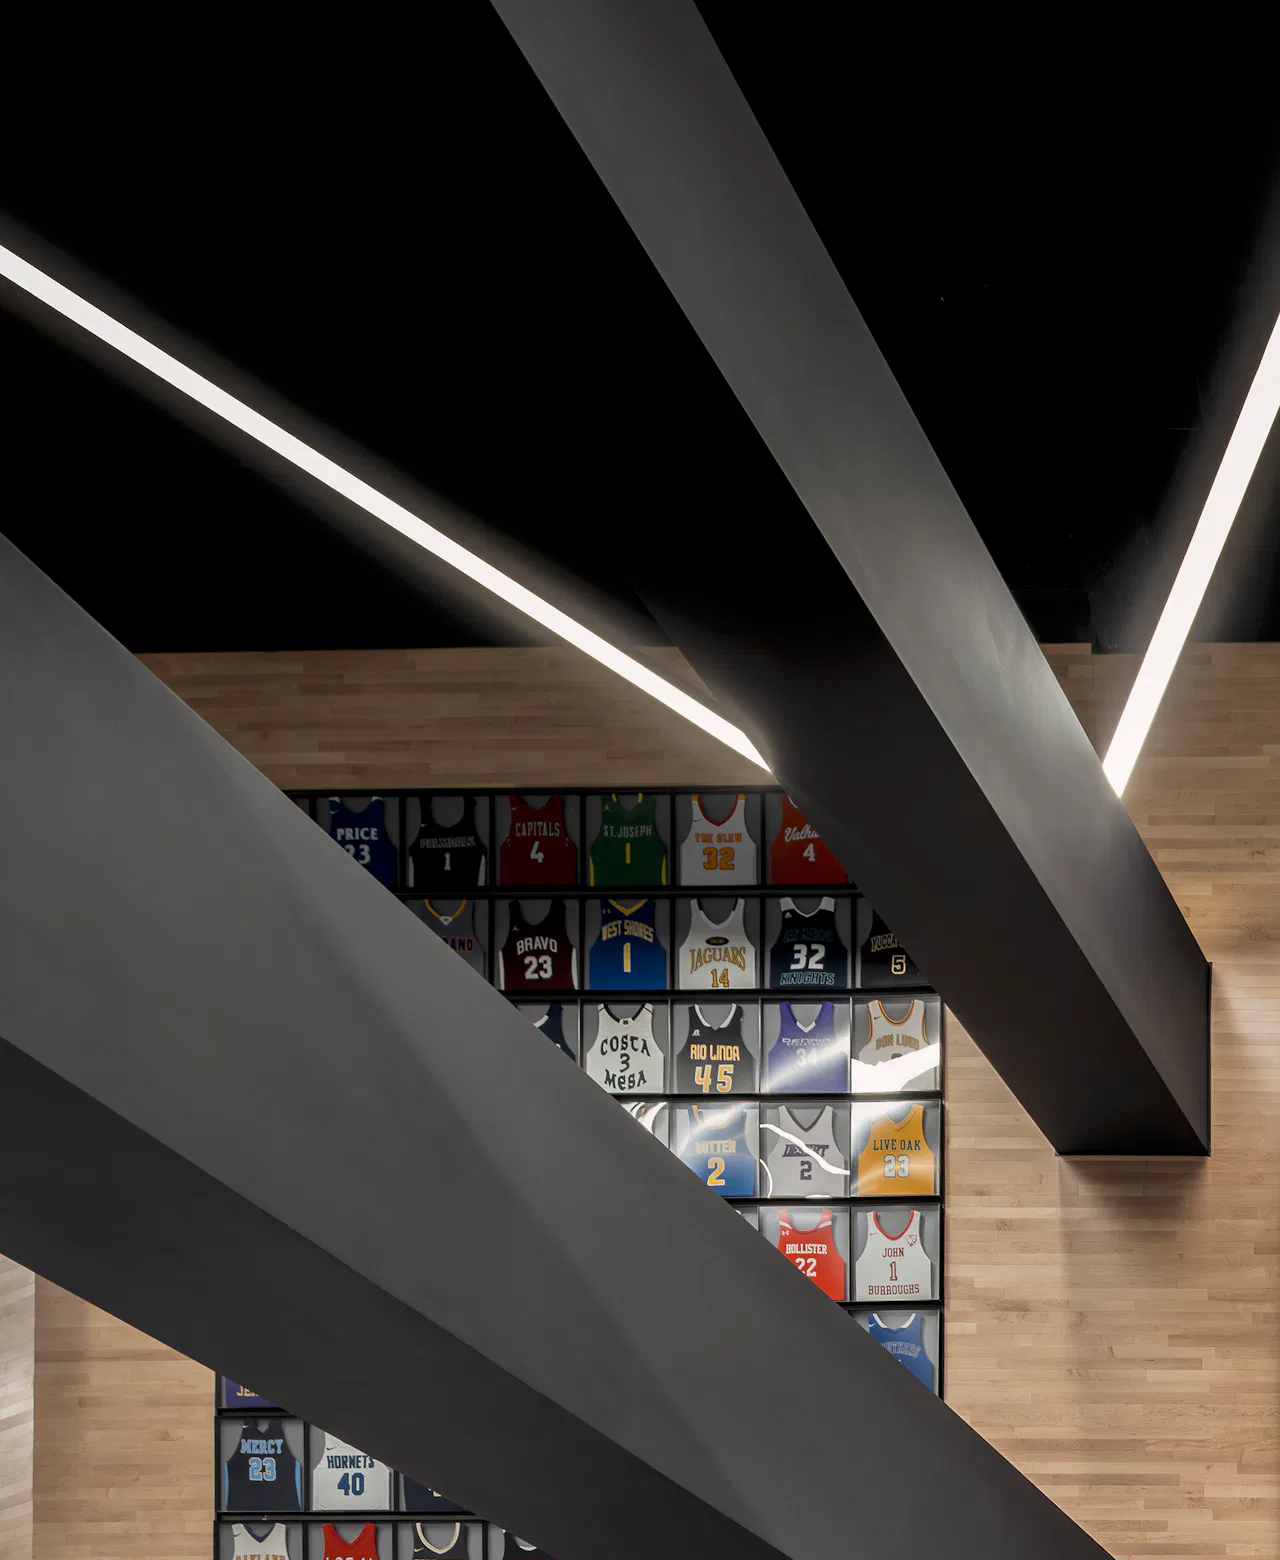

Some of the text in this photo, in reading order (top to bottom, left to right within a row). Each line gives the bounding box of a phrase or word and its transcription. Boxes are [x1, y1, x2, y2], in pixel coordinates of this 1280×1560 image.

[336, 828, 378, 841] PRICE
[515, 821, 560, 838] CAPITALS
[702, 846, 735, 870] 32
[516, 936, 557, 956] BRAVO
[790, 943, 825, 969] 32
[524, 955, 553, 980] 23
[690, 946, 746, 973] JAGUARS
[695, 1065, 733, 1092] 45
[873, 1139, 921, 1151] LIVE OAK
[786, 1244, 827, 1255] HOLLISTER
[882, 1247, 904, 1258] JOHN
[868, 1284, 920, 1295] BURROUGHS
[240, 1439, 283, 1454] MERCY
[249, 1457, 277, 1482] 23
[337, 1473, 364, 1496] 40
